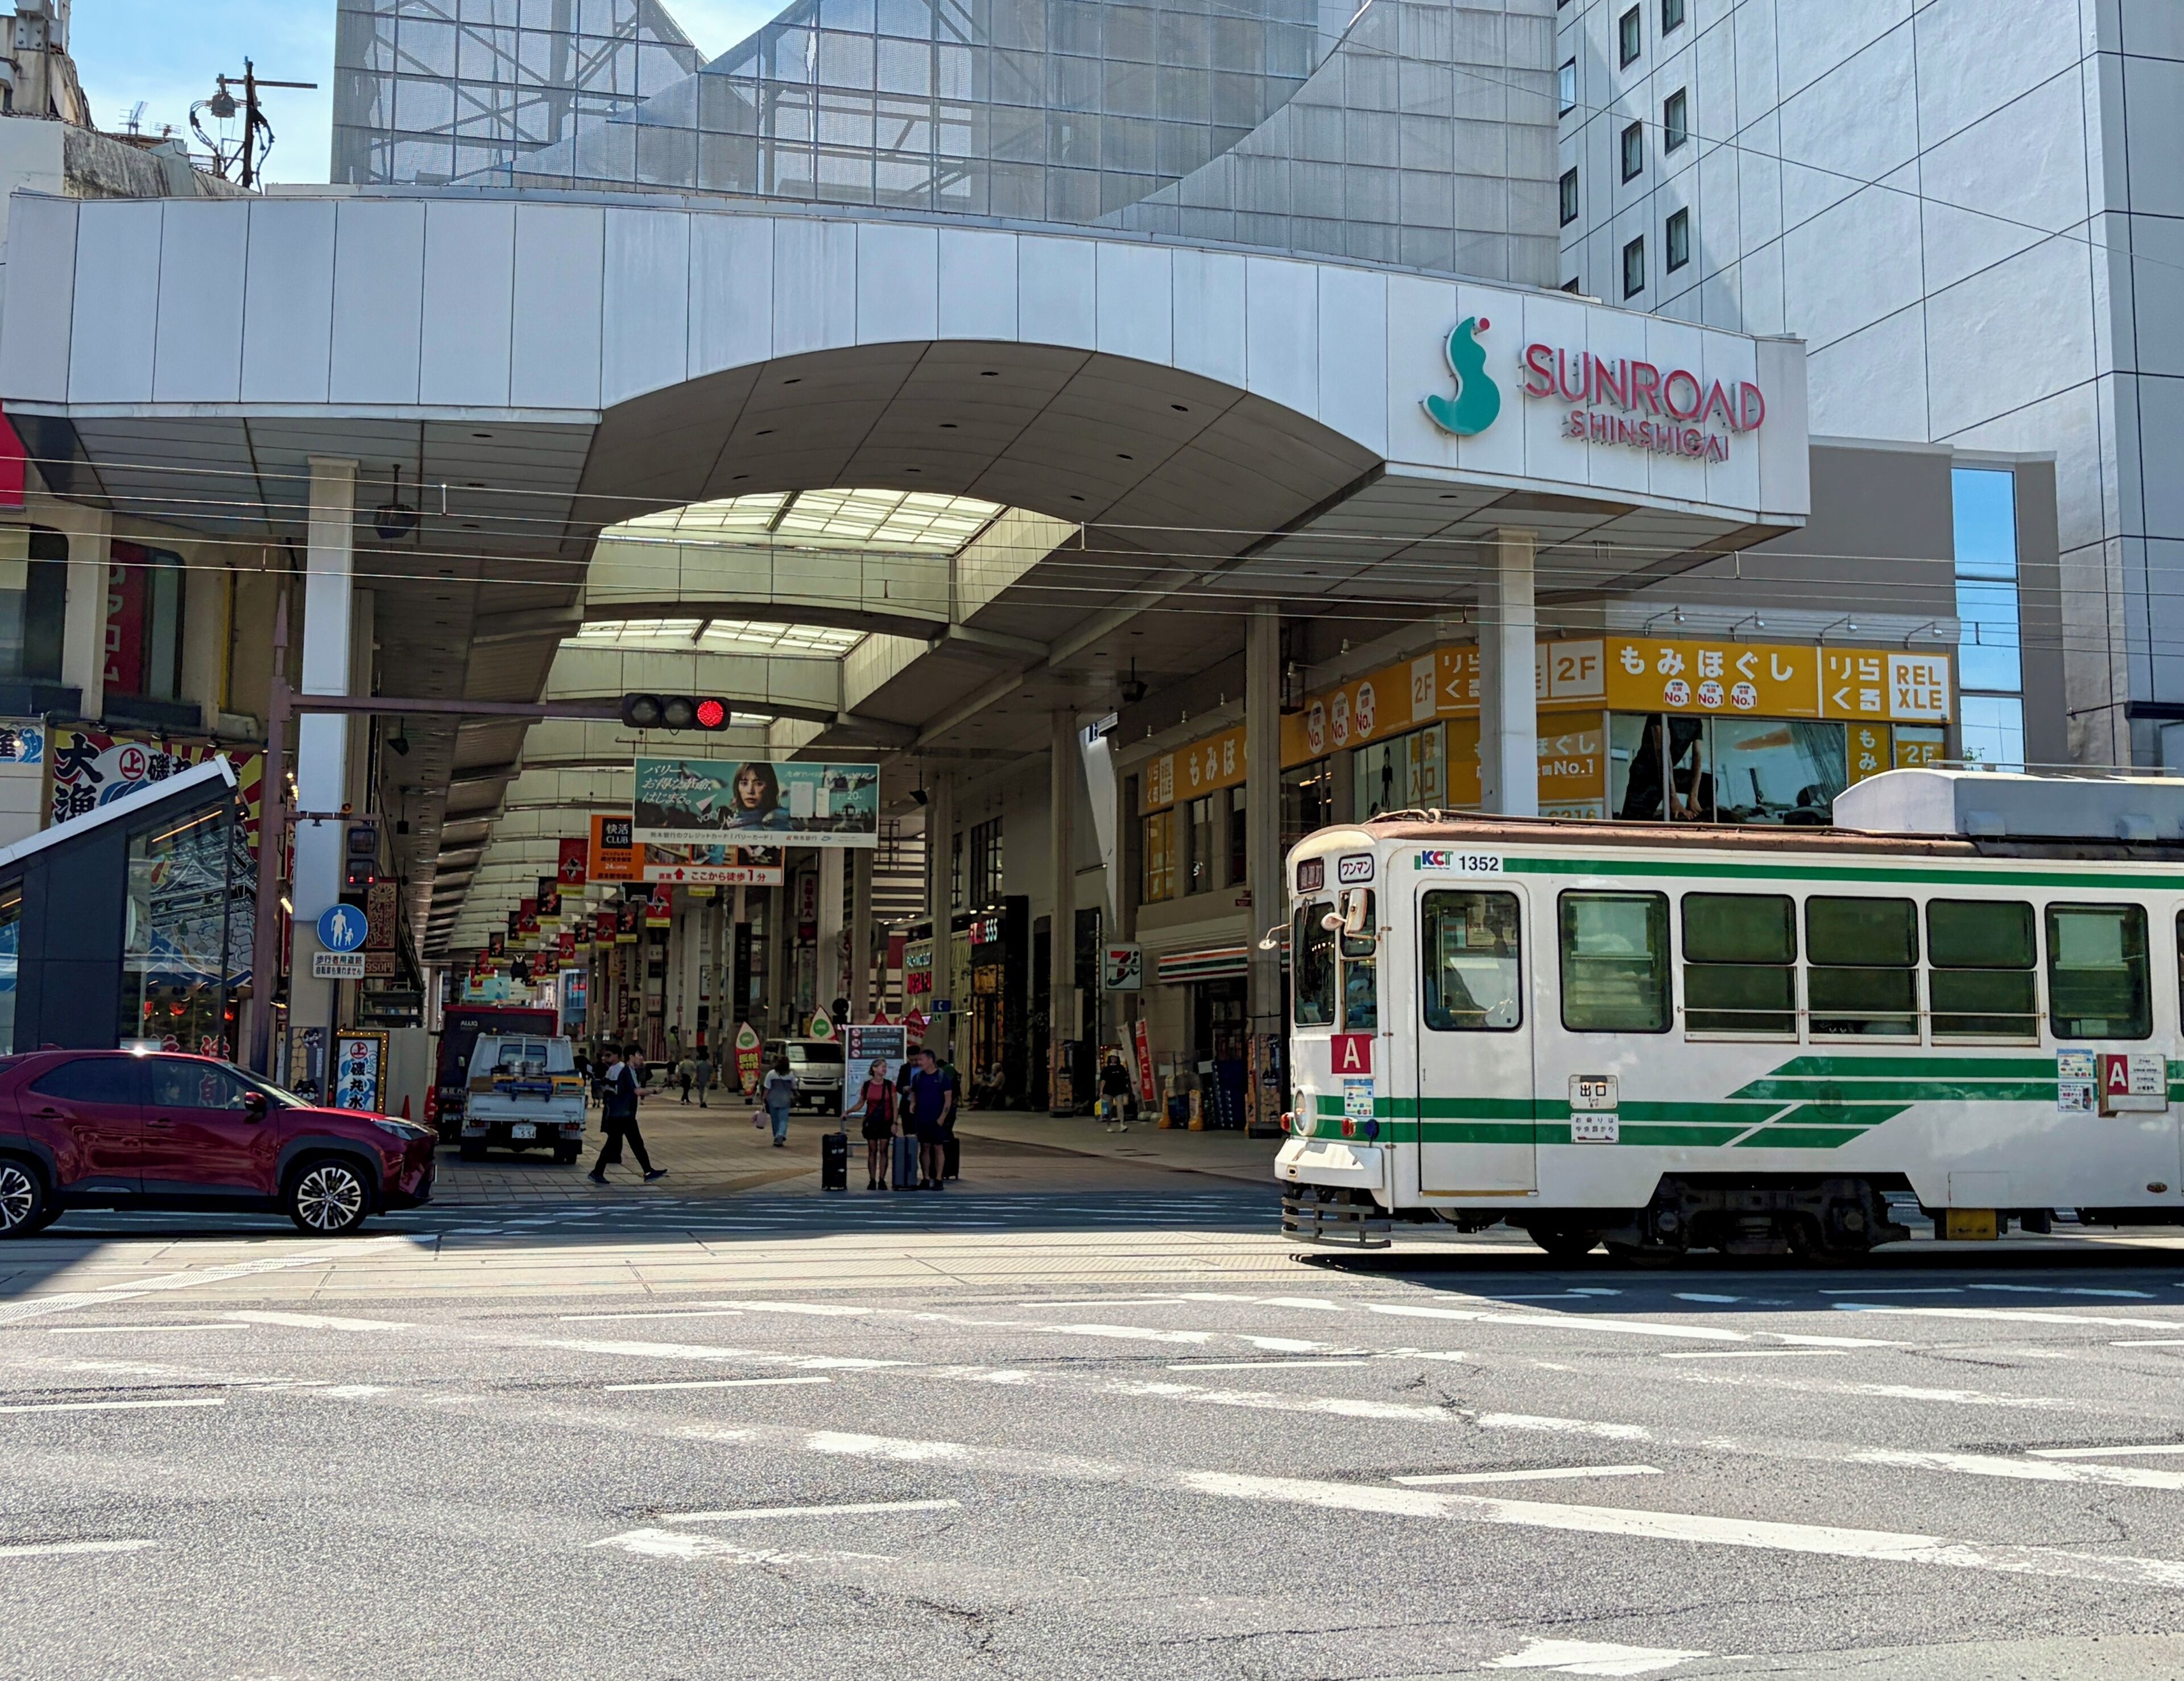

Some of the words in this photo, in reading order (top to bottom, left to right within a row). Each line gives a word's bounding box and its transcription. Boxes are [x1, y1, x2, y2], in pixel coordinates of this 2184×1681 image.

[1521, 343, 1765, 432] SUNROAD
[1567, 410, 1729, 461] SHINSHIGAI
[1557, 656, 1596, 682] 2F
[1620, 646, 1793, 681] もみほぐし
[1830, 656, 1880, 682] りら
[1896, 664, 1941, 687] REL
[1414, 673, 1433, 704] 2F
[1664, 692, 1690, 703] No.1
[1698, 693, 1724, 705] No.1
[1832, 687, 1880, 711] くる
[1897, 688, 1942, 710] XLE
[1731, 695, 1756, 706] No.1
[1190, 739, 1247, 787] もみほ
[1906, 745, 1934, 763] 2F
[643, 765, 682, 775] バリー
[1411, 766, 1435, 796] 入口
[606, 835, 628, 845] CLUB
[1342, 861, 1371, 876] ワンマン
[1422, 850, 1454, 866] KCT
[1458, 856, 1499, 872] 1352
[690, 869, 766, 882] ここから徒歩1分
[1342, 1037, 1361, 1069] A
[2109, 1062, 2127, 1087] A
[1580, 1084, 1607, 1097] 出口
